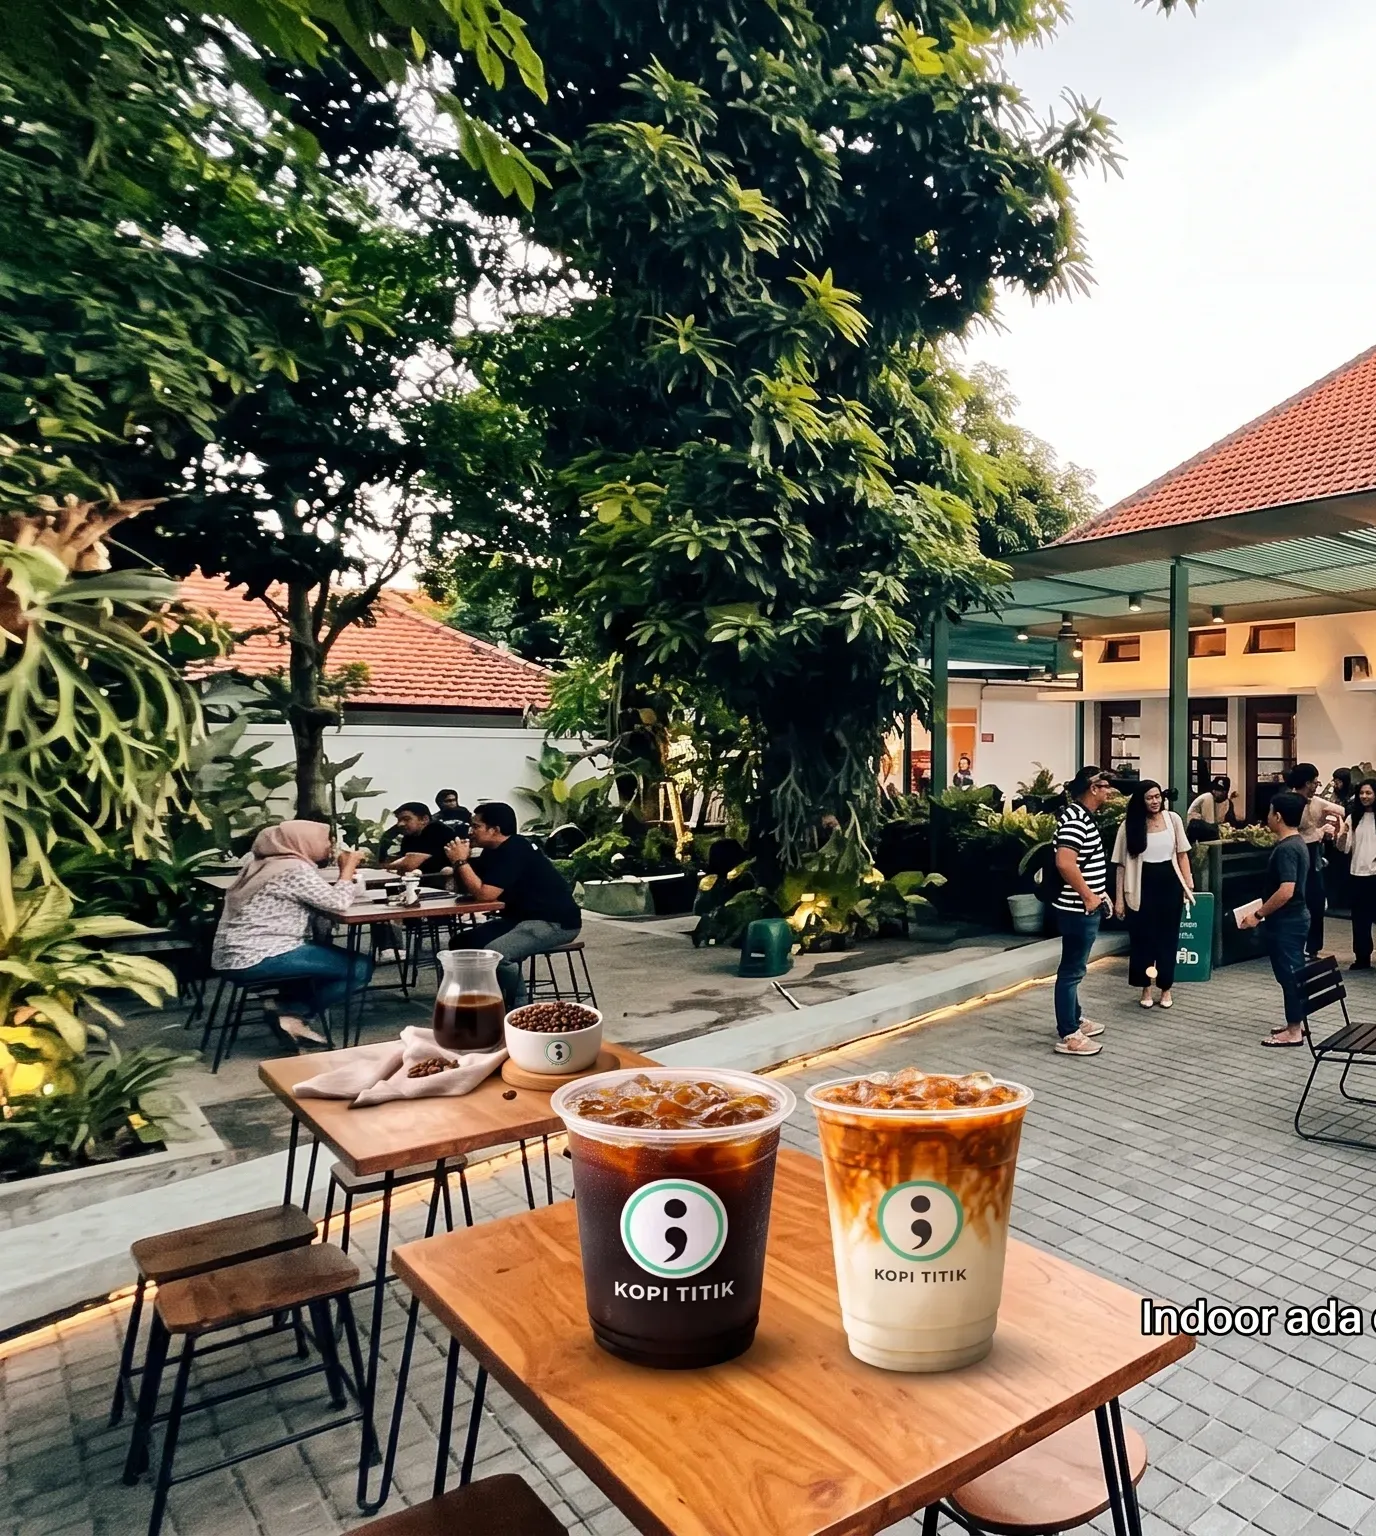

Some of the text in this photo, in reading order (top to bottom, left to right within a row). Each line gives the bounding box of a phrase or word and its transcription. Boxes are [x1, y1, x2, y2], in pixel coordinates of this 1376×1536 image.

[874, 1268, 967, 1283] KOPI TITIK
[614, 1280, 735, 1302] KOPI TITIK
